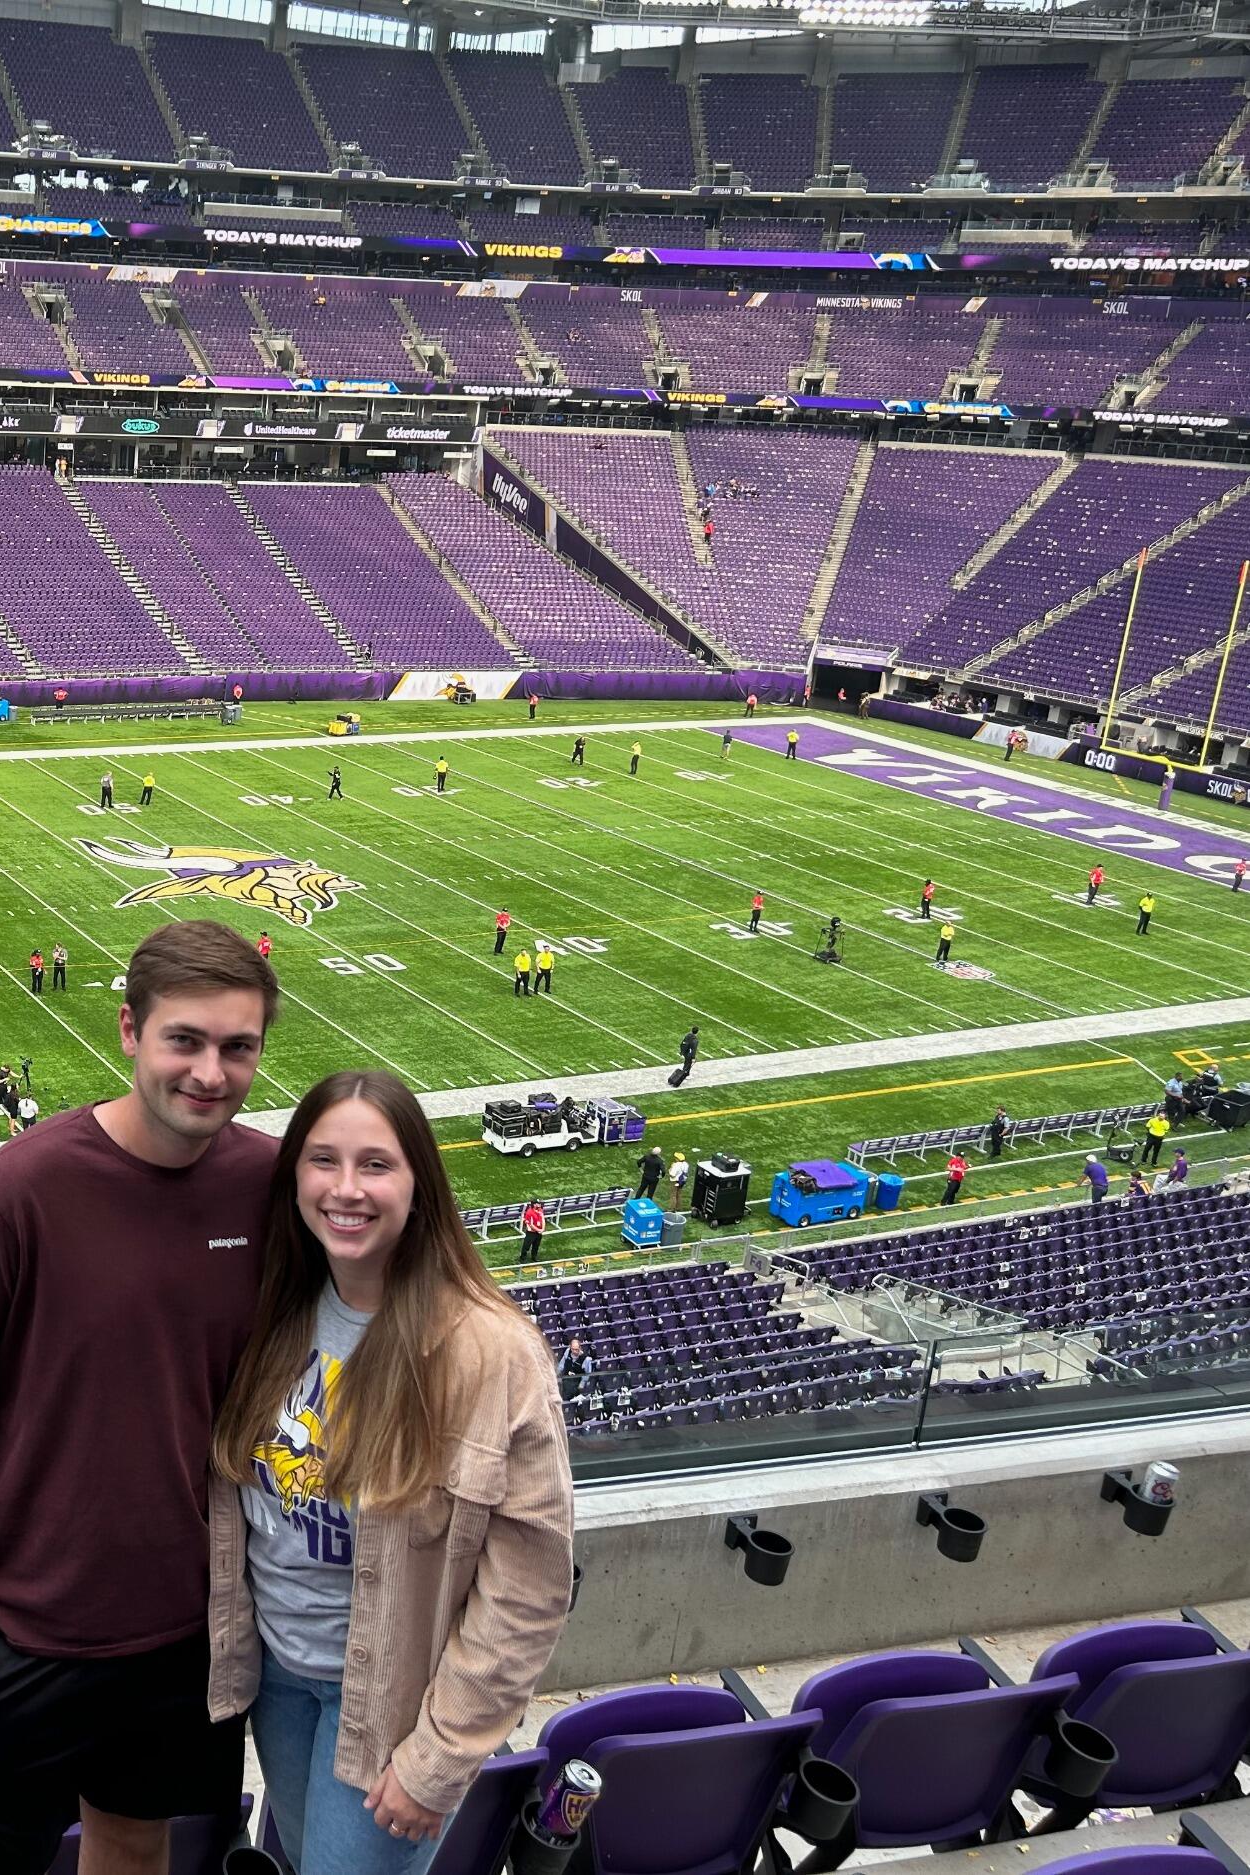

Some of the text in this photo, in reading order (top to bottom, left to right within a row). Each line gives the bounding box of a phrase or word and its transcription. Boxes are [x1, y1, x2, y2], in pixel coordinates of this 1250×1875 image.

[203, 229, 363, 249] TODAY'S MATCHUP
[484, 243, 563, 259] VIKINGS
[1050, 257, 1250, 271] TODAY'S MATCHUP
[620, 290, 643, 303] SKOL
[816, 296, 902, 309] MINNESOTA VIKINGS
[1102, 301, 1129, 315] SKOL
[93, 373, 150, 385] VIKINGS
[462, 385, 573, 397] TODAY'S MATCHUP
[667, 392, 727, 403] VIKINGS
[1092, 411, 1229, 428] TODAY'S MATCHUP
[255, 425, 317, 436] UnitedHealthcare
[386, 426, 450, 440] ticketmaster
[1084, 749, 1116, 771] 0:00
[1206, 779, 1234, 799] SKOL
[317, 952, 408, 975] 50
[208, 1236, 248, 1250] patagonia
[749, 1256, 763, 1273] F4
